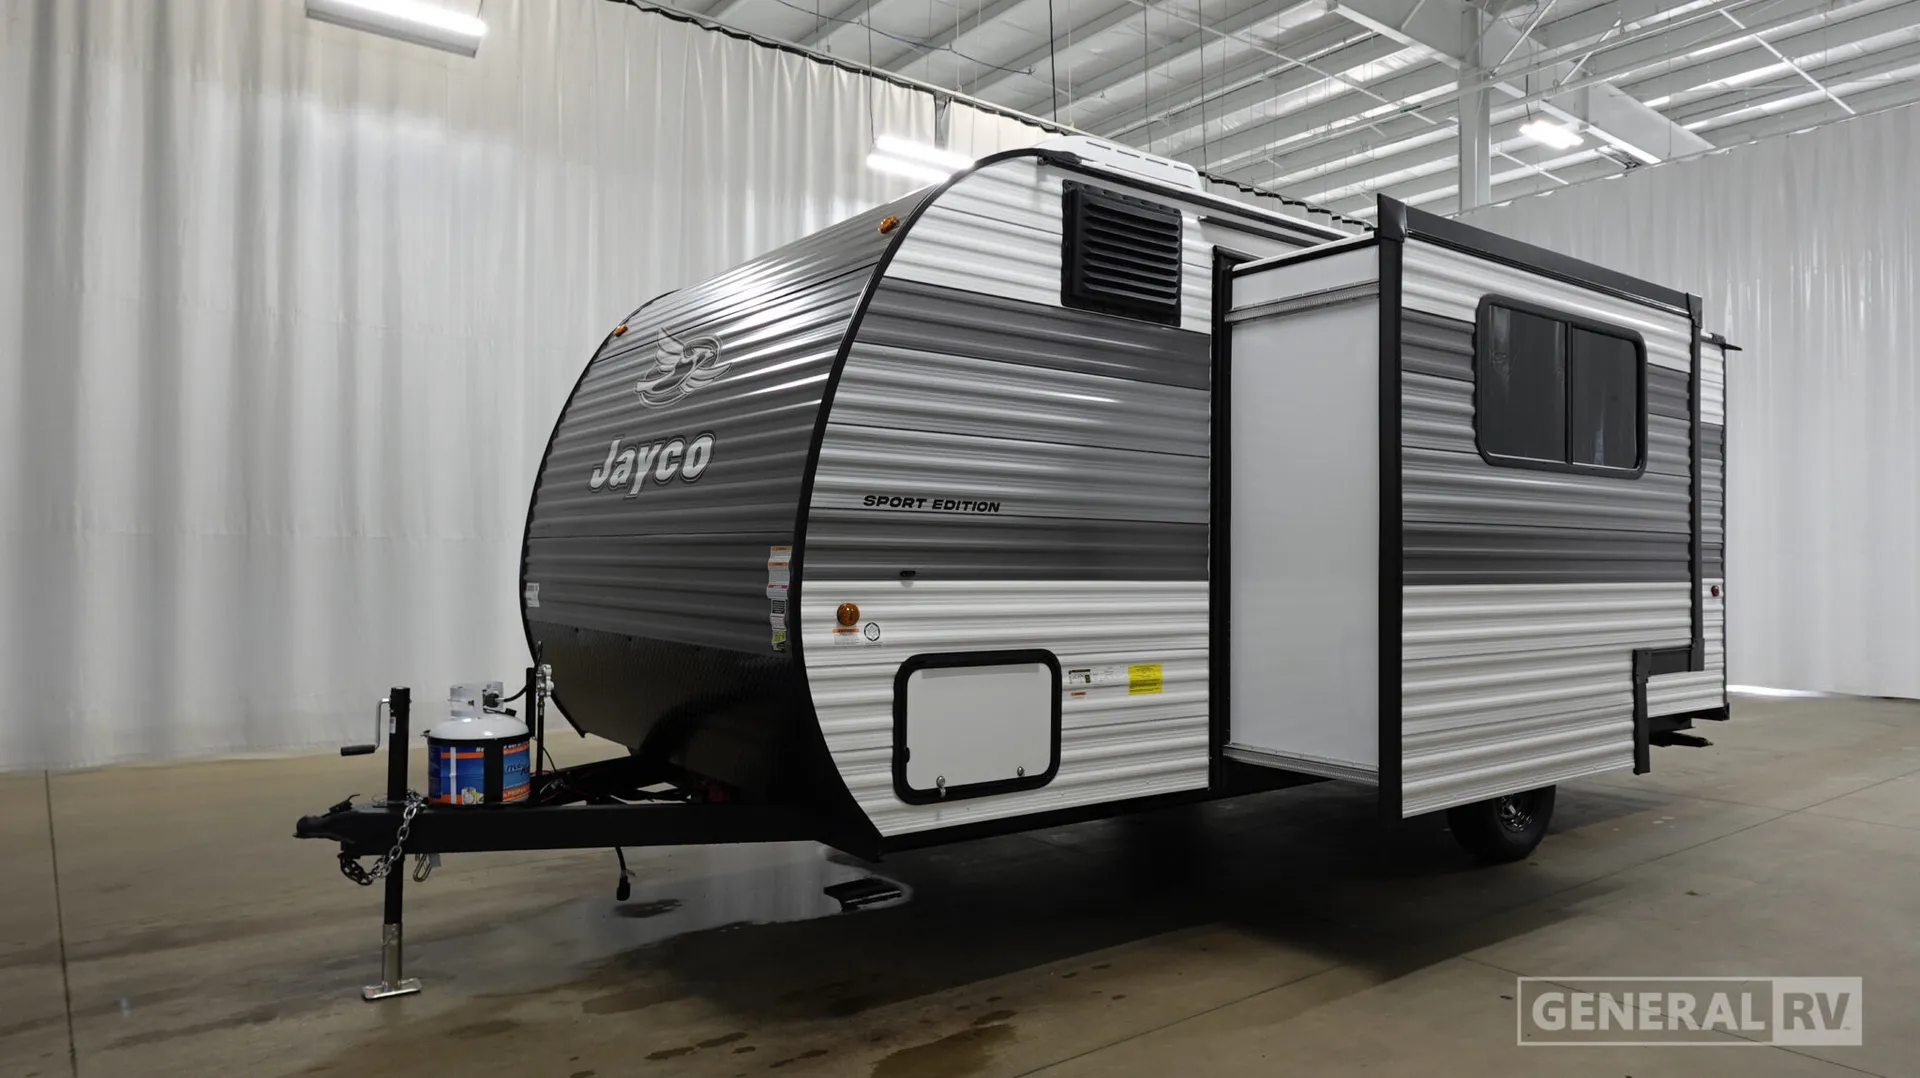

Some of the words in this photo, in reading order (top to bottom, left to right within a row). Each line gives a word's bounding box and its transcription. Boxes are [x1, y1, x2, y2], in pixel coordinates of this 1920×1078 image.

[589, 433, 714, 497] Jayco
[863, 495, 927, 508] SPORT
[932, 499, 1000, 512] EDITION
